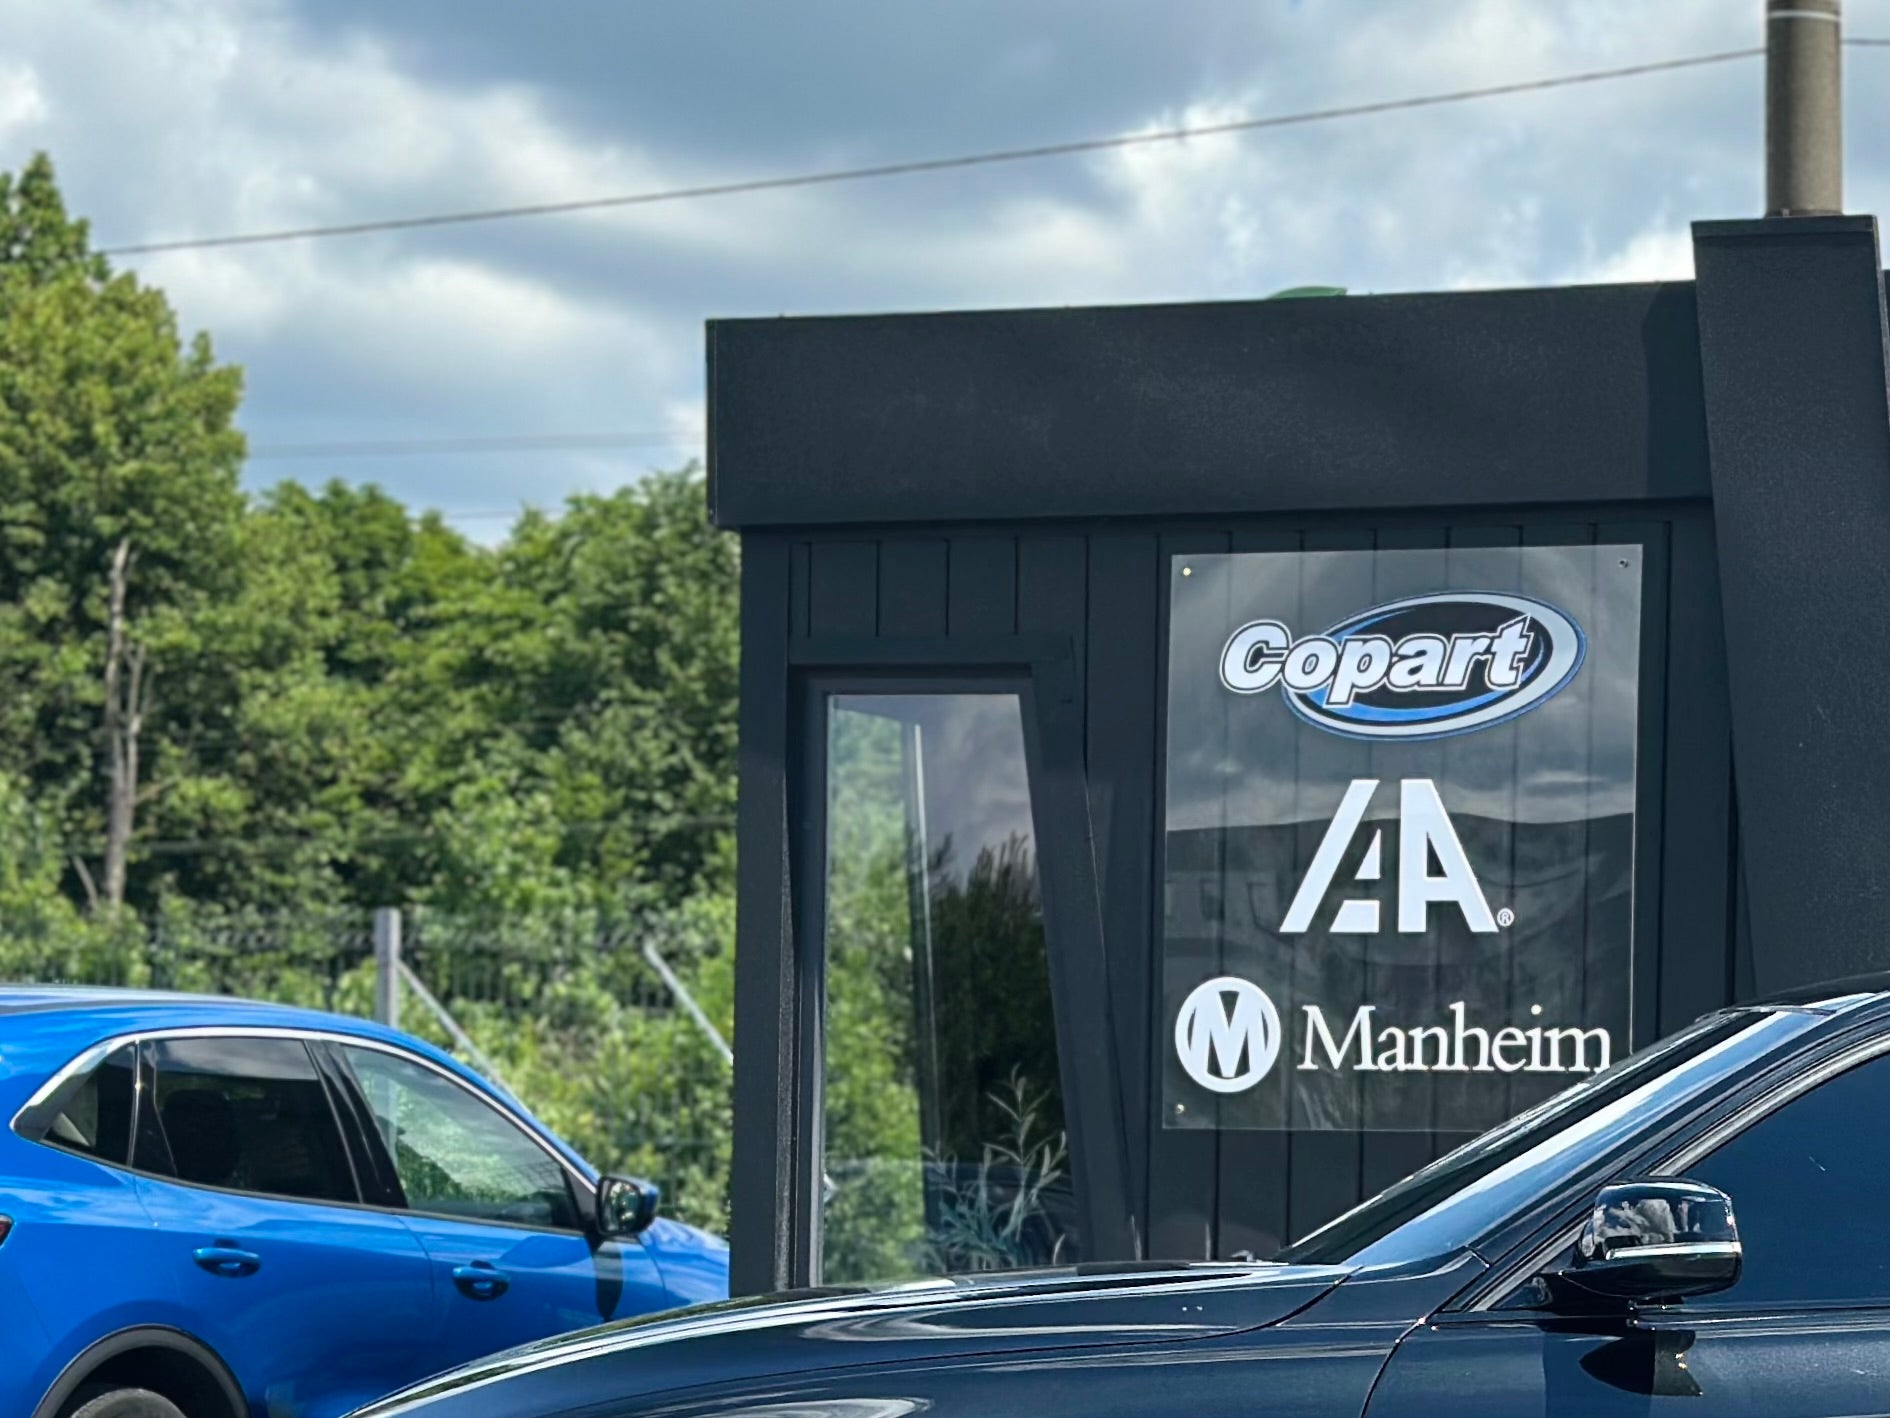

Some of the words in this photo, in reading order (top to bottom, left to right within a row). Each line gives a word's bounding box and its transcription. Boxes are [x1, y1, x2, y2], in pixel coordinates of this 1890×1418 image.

[1221, 614, 1531, 708] Copart
[1175, 977, 1281, 1093] M
[1297, 1001, 1611, 1079] Manheim
